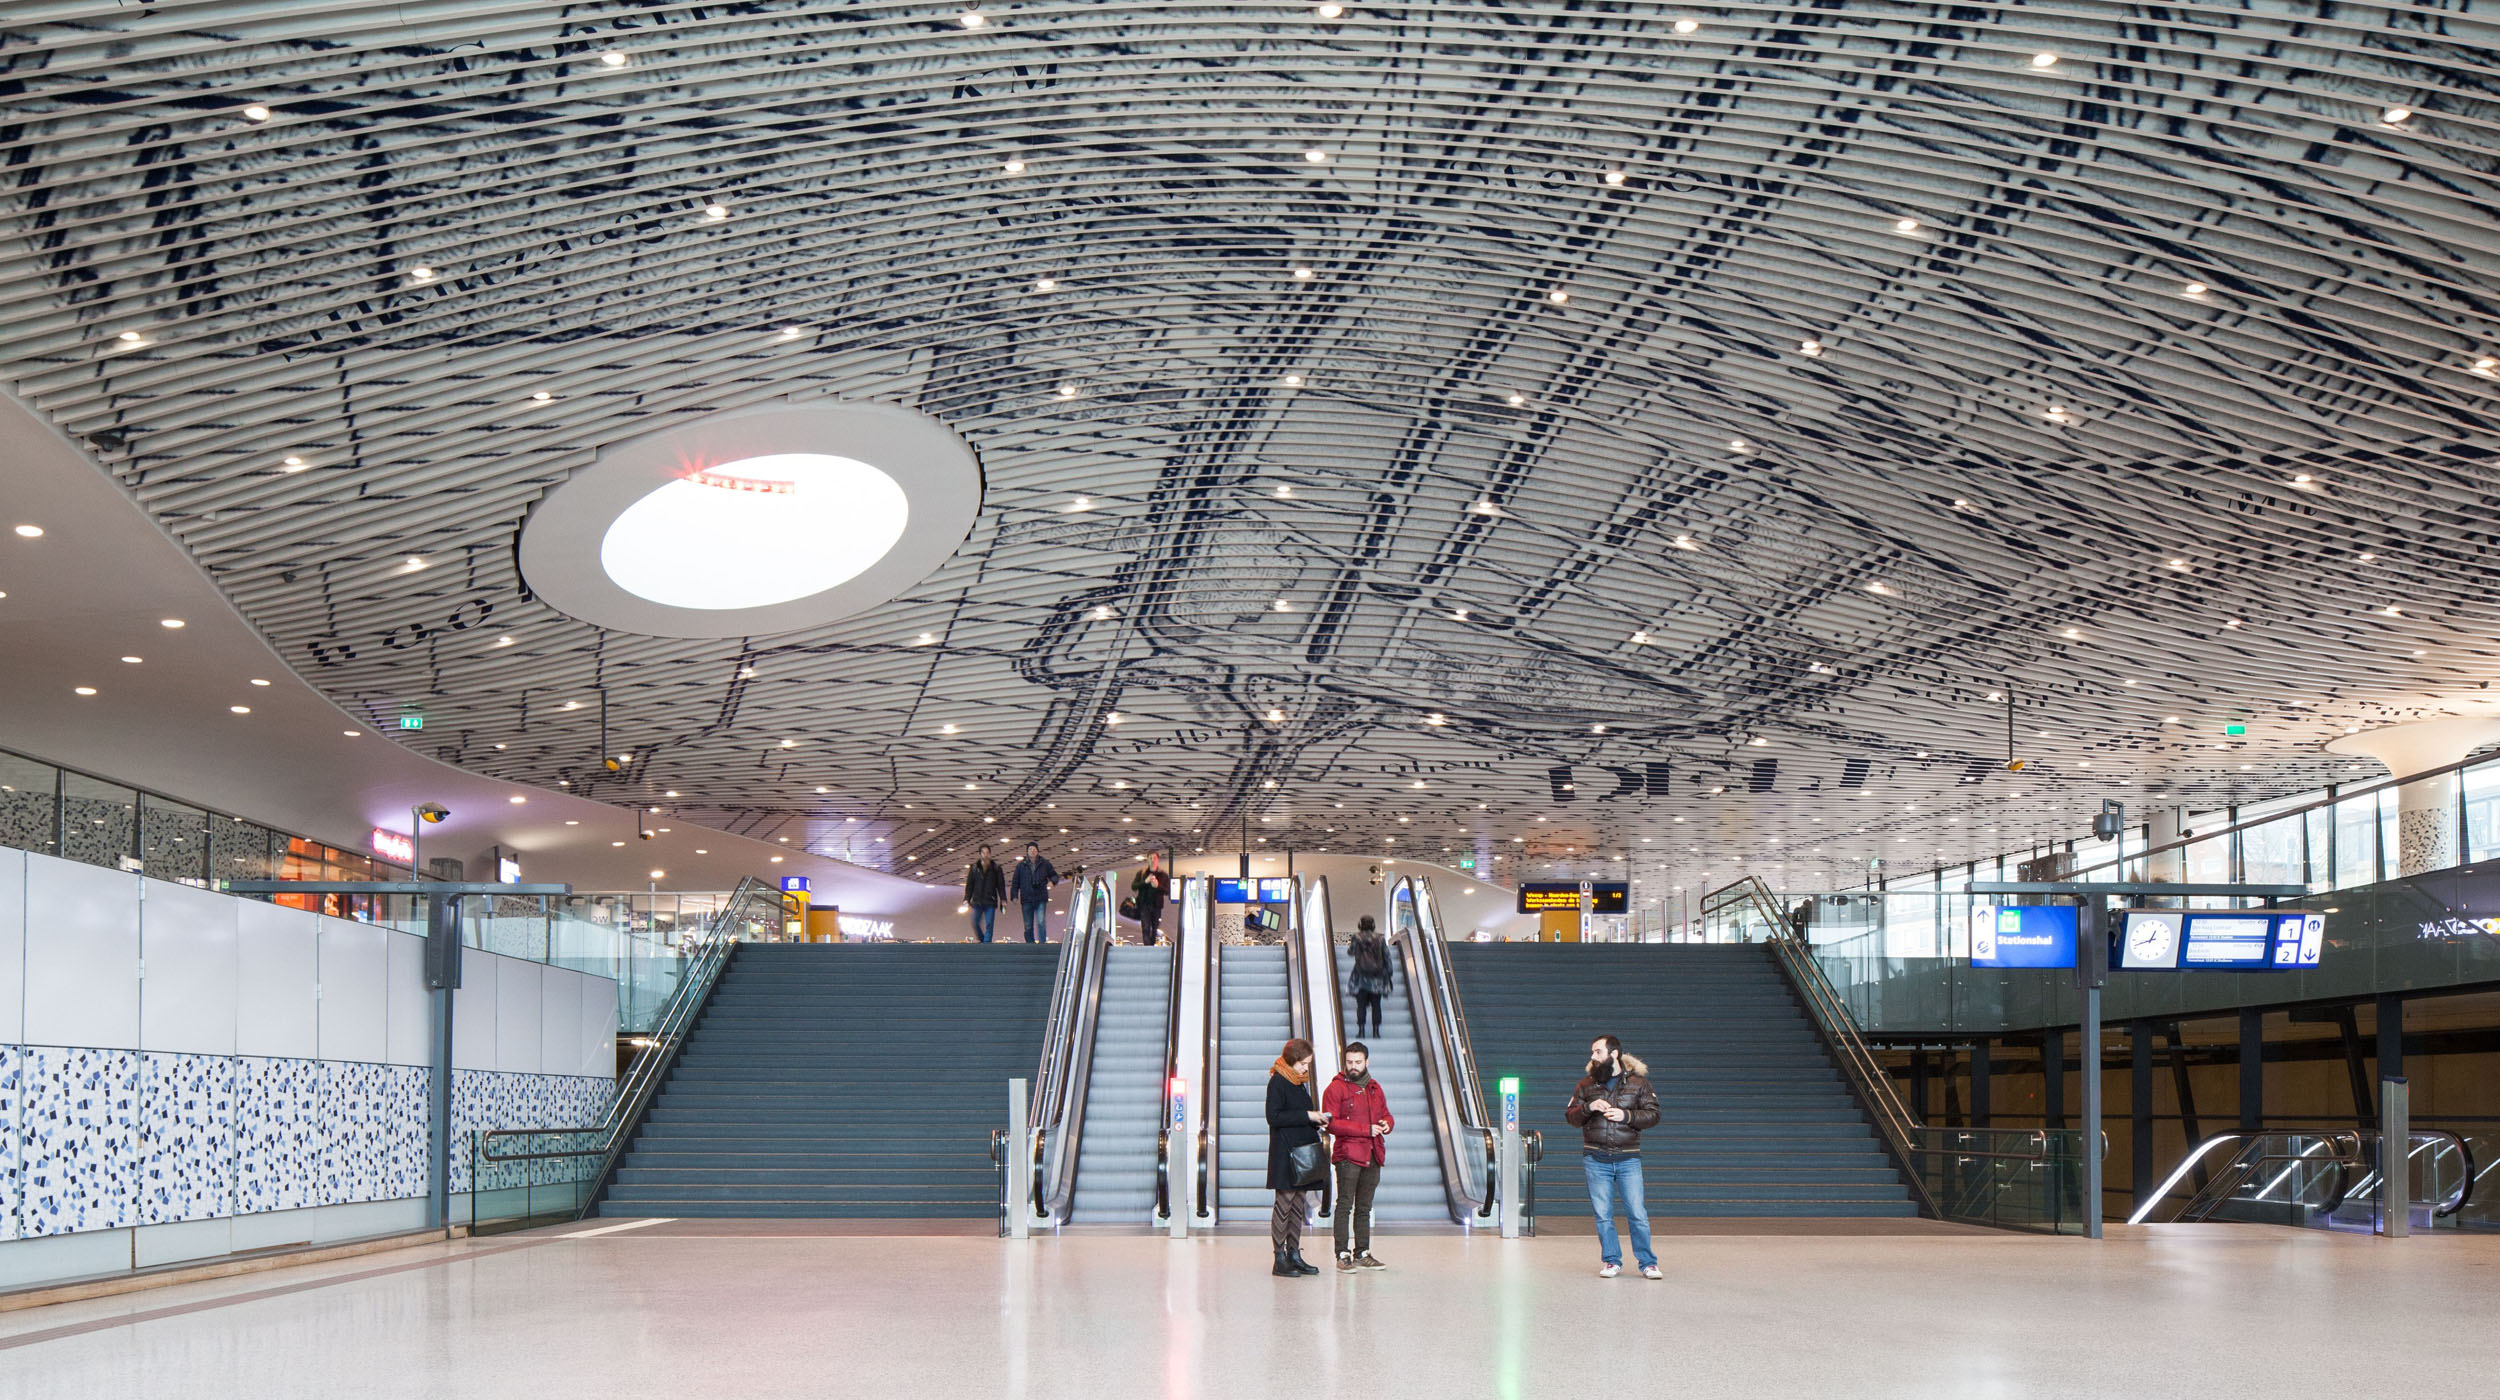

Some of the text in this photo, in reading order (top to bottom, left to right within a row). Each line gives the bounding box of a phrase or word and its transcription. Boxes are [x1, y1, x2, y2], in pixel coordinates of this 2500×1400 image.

[2288, 928, 2293, 938] 1
[1997, 935, 2053, 945] Stationshal
[2282, 951, 2290, 961] 2
